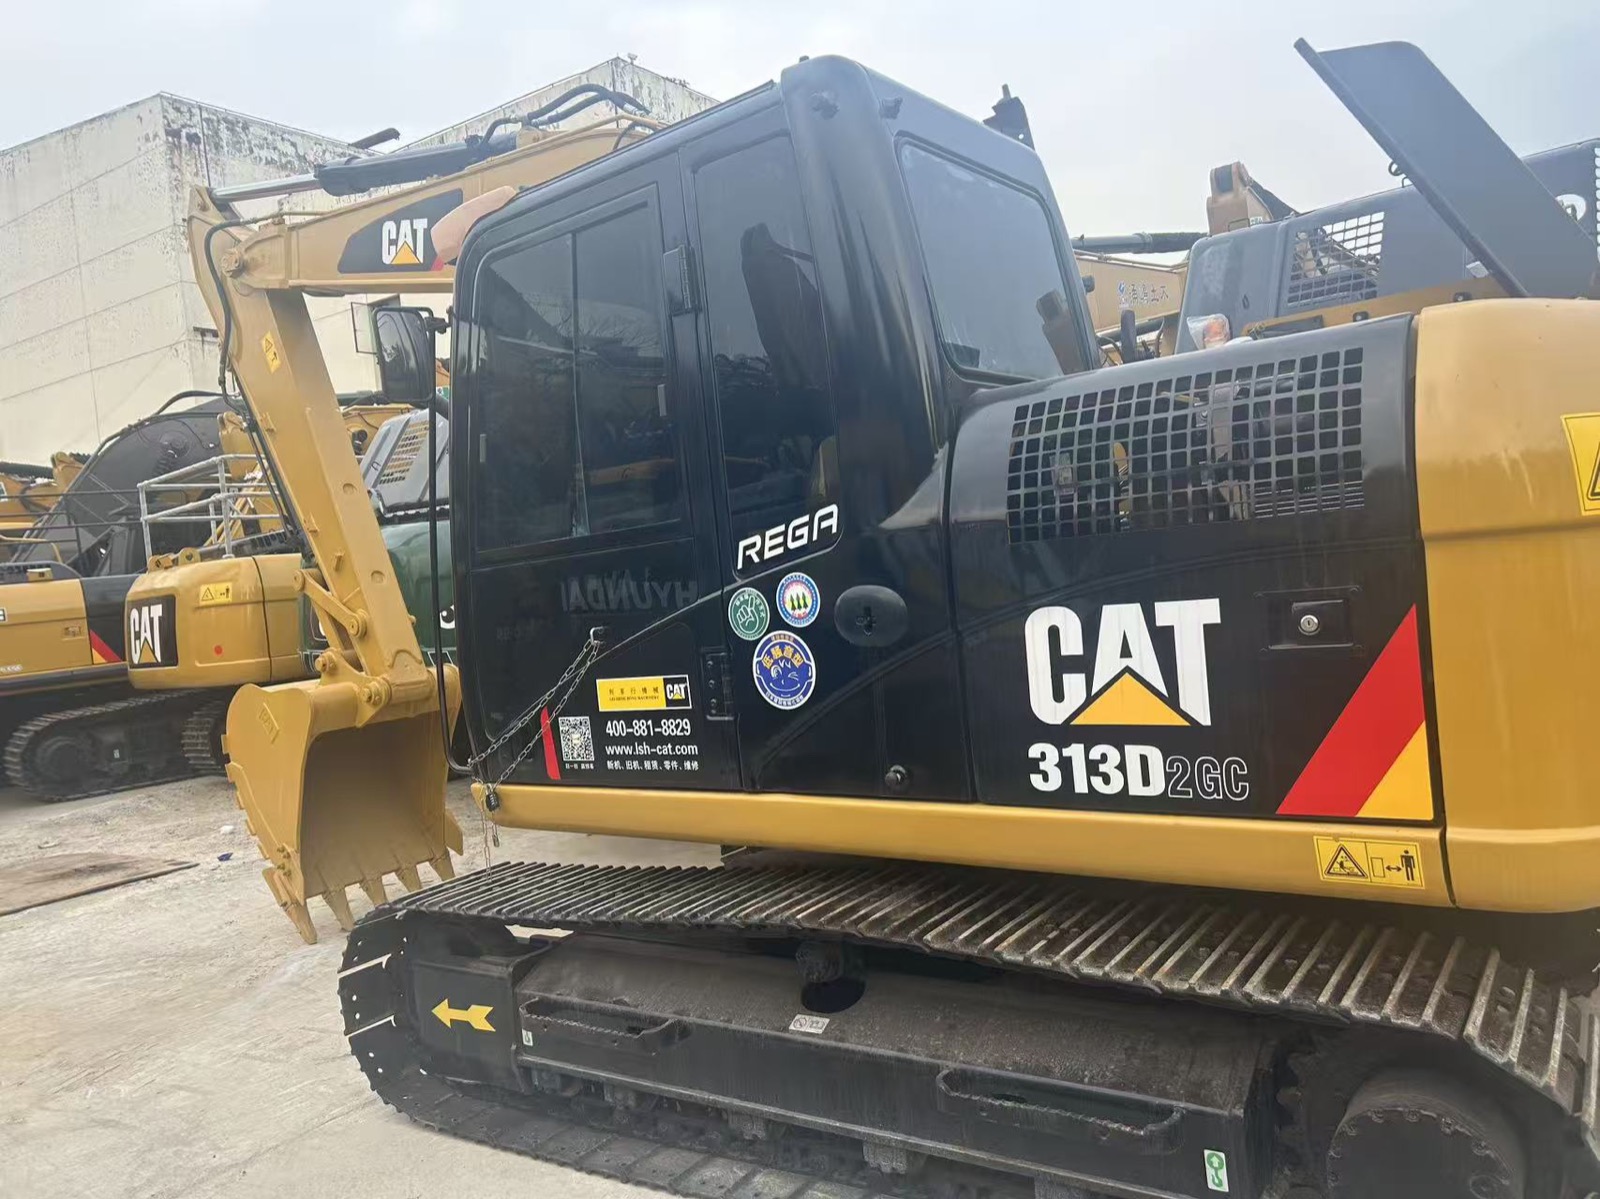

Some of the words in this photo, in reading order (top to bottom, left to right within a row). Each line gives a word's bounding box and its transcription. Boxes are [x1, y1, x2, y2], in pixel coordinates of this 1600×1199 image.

[382, 218, 428, 265] CAT
[737, 503, 839, 570] REGA
[129, 603, 163, 665] CAT
[1024, 598, 1222, 727] CAT
[666, 683, 687, 700] CAT
[605, 718, 691, 737] 400-881-8829
[605, 742, 698, 755] www.lsh-cat.com
